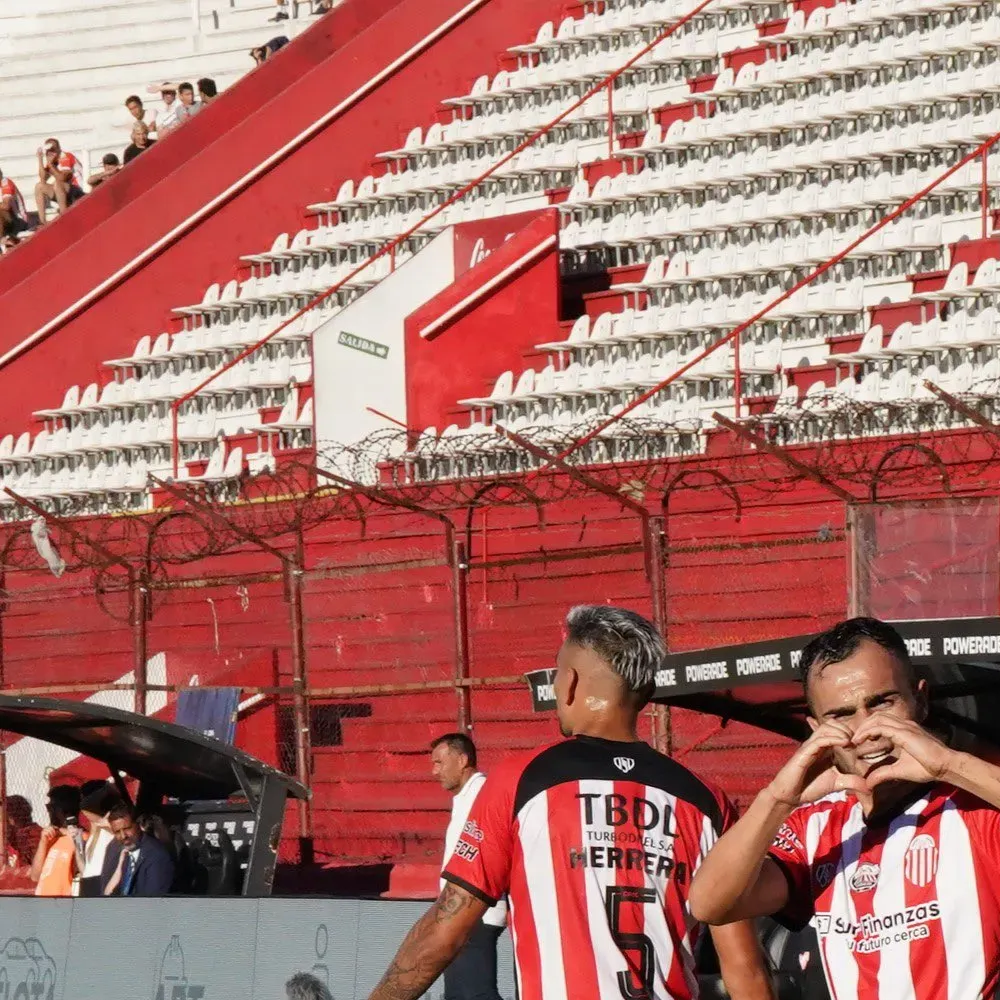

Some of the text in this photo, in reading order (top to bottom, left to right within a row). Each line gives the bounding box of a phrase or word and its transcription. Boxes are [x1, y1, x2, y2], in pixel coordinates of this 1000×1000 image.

[338, 332, 376, 353] SALIDA
[686, 661, 729, 682] POWERADE
[736, 653, 782, 676] POWERADE
[654, 668, 677, 687] RADE
[575, 793, 680, 838] TBDL
[571, 846, 687, 885] HERRERA
[861, 903, 940, 936] Finanzas
[894, 926, 928, 943] cerca
